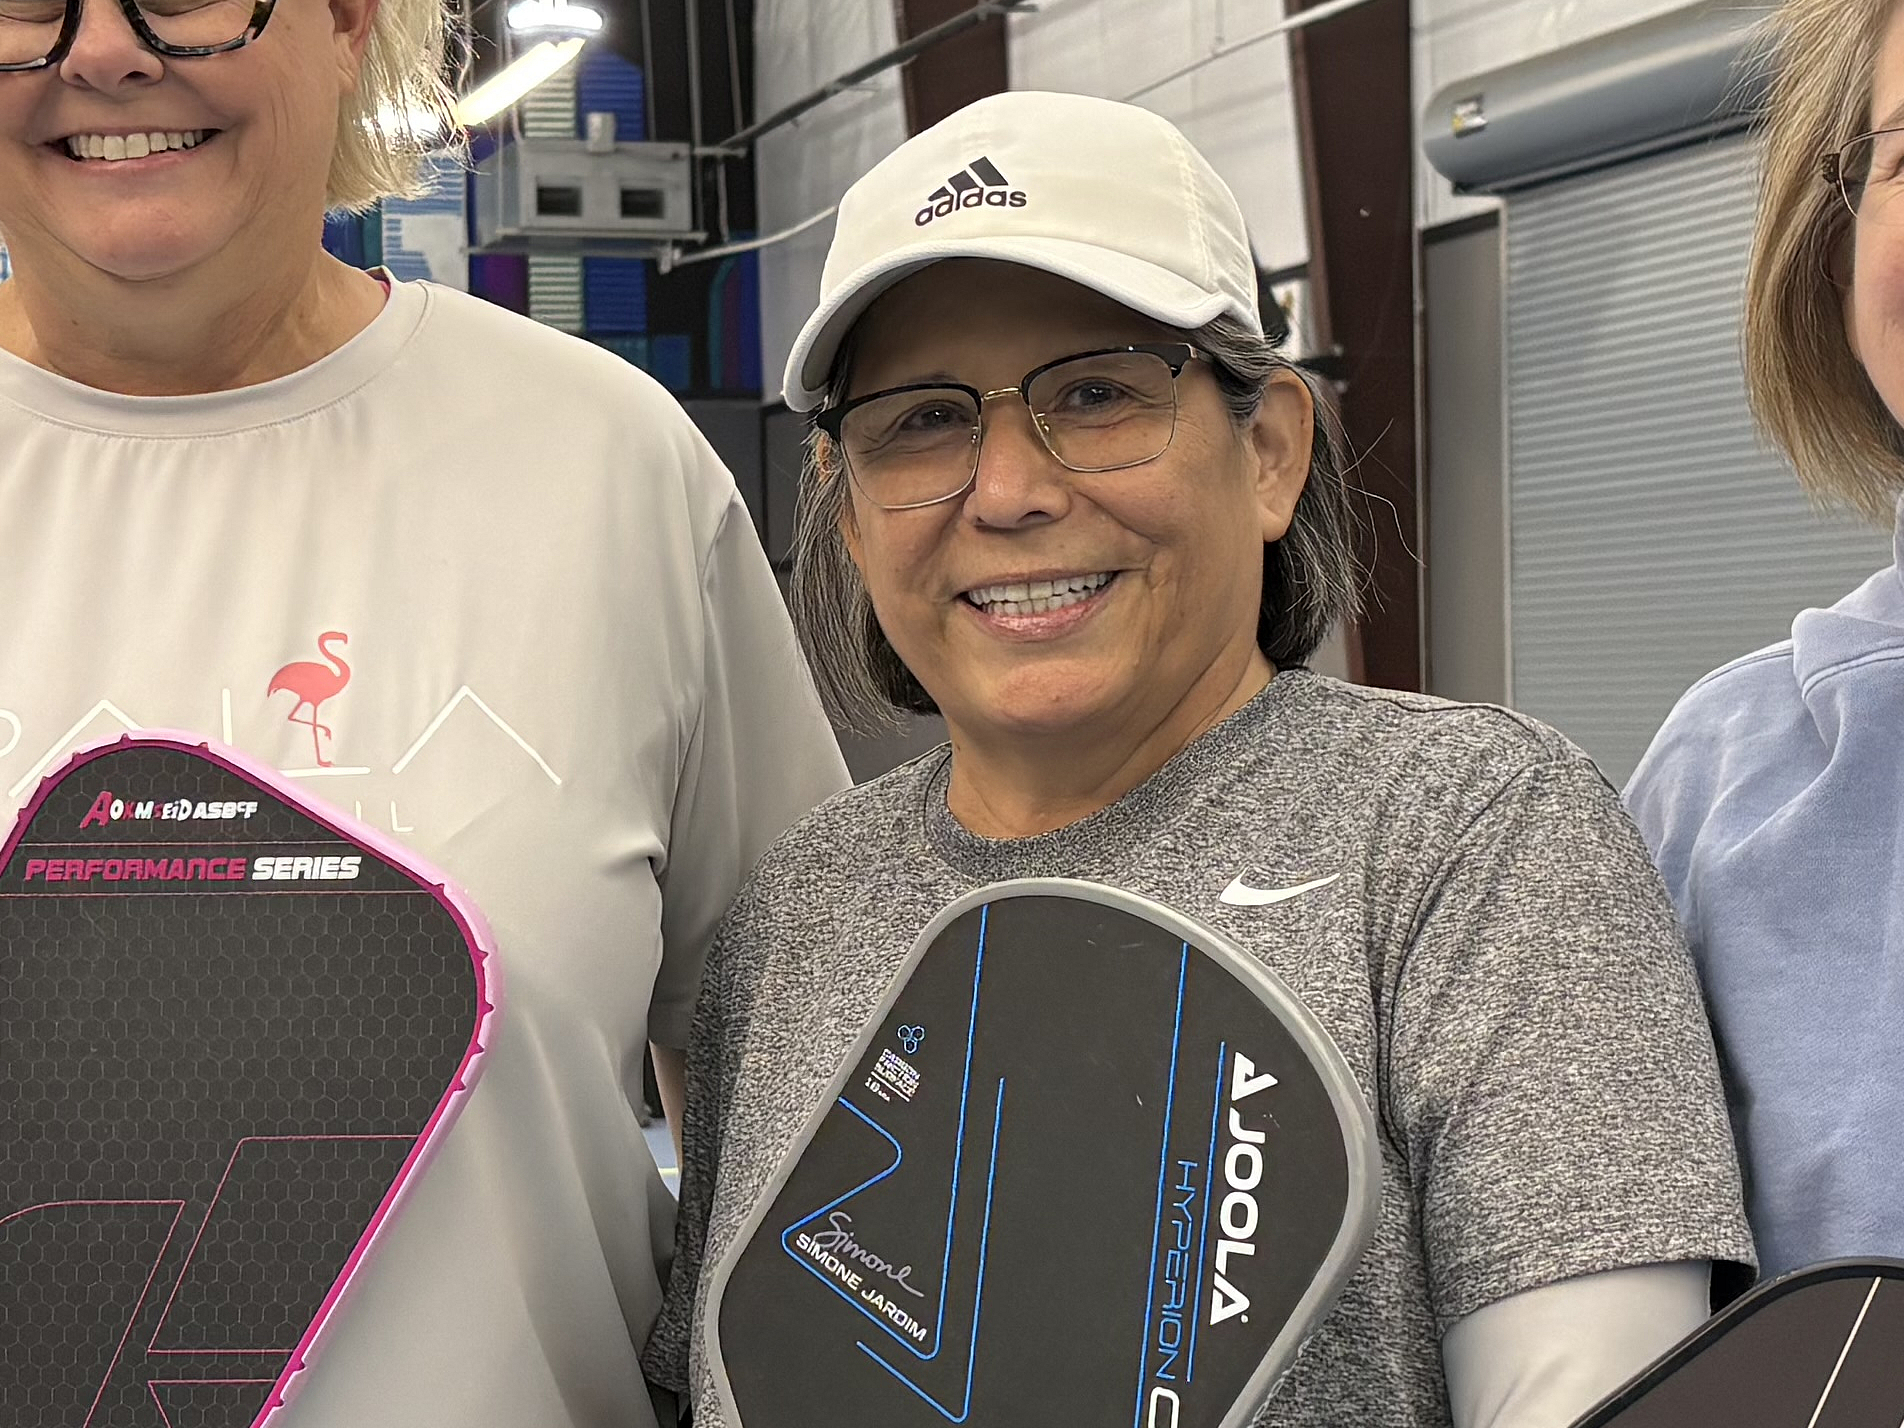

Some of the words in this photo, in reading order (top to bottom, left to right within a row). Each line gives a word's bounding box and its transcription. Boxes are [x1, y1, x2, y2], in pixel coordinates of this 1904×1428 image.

[914, 186, 1028, 227] adidas
[23, 857, 248, 882] PERFORMANCE
[251, 855, 362, 881] SERIES
[813, 1211, 925, 1298] Simone
[1209, 1106, 1267, 1326] JOOLA
[795, 1232, 864, 1291] SIMONE
[860, 1289, 928, 1342] JARDIM
[1155, 1159, 1199, 1381] HYPERION
